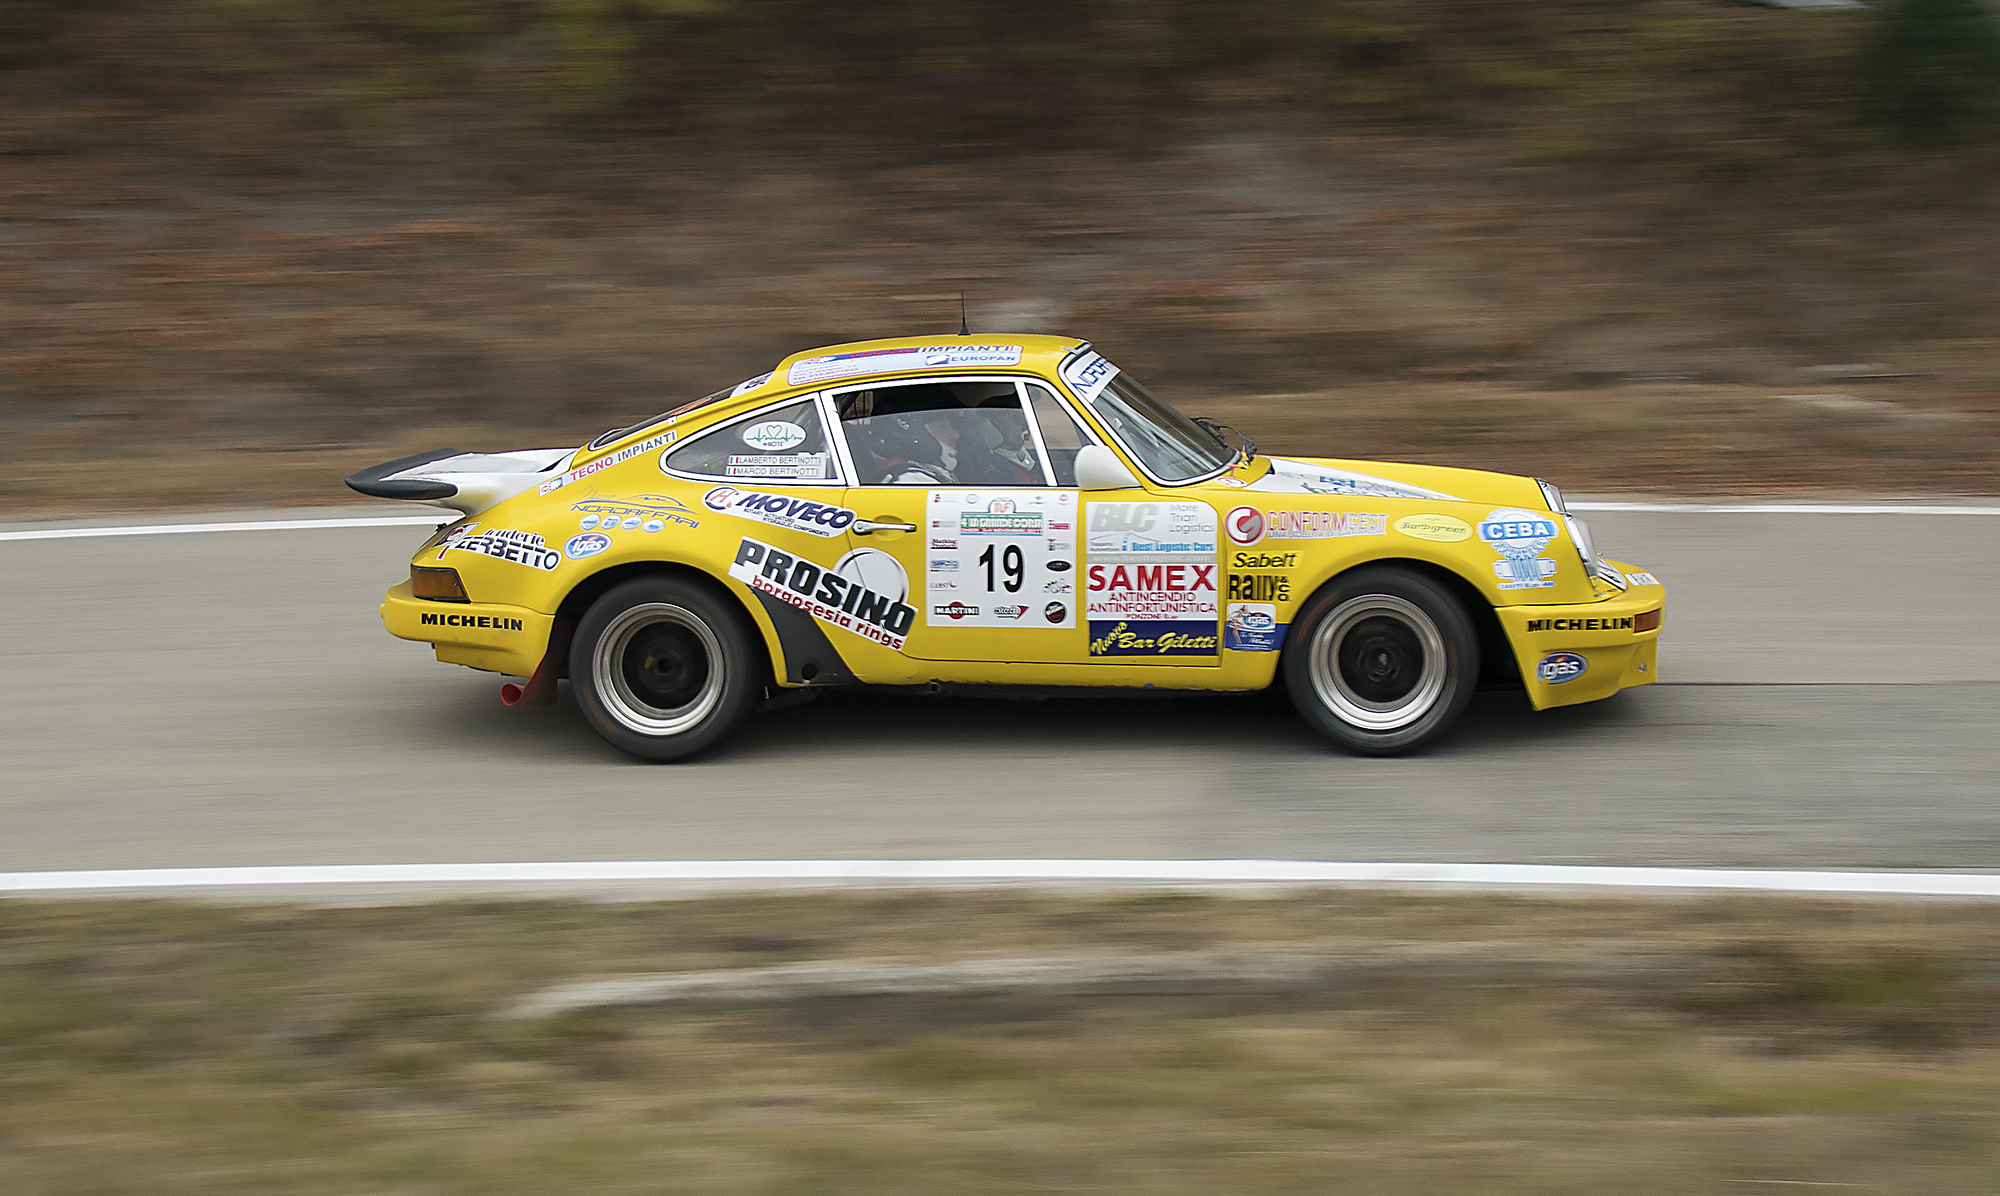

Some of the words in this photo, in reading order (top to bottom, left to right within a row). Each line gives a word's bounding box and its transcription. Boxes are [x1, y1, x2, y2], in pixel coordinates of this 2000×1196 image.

[921, 345, 1010, 353] IMPIANTI
[570, 456, 614, 482] TECNO
[617, 431, 676, 462] IMPIANTI
[739, 456, 777, 464] LAMBERTO
[779, 456, 821, 464] BERTINOTTI
[735, 493, 855, 529] MOVECO
[1091, 503, 1160, 532] BLC
[1171, 504, 1199, 512] More
[1171, 512, 1198, 522] Than
[1170, 523, 1216, 535] Logistics
[1488, 522, 1550, 539] CEBA
[454, 535, 560, 570] ZERBETTO
[571, 537, 605, 557] igas
[979, 543, 1025, 593] 19
[1233, 552, 1298, 568] Sabelt
[734, 539, 916, 637] PROSINO
[1089, 565, 1217, 592] SAMEX
[1228, 574, 1278, 601] Rally
[1109, 592, 1196, 602] ANTINCENDIO
[752, 575, 852, 627] borgosesia
[856, 622, 903, 650] rings
[935, 607, 979, 615] MARTINI
[1087, 602, 1218, 612] ANTINFORTUNISTICA
[421, 613, 523, 631] MICHELIN
[1527, 616, 1634, 632] MICHELIN
[1117, 632, 1155, 649] Bar
[1156, 632, 1218, 653] Giletti
[1541, 659, 1580, 681] igas
